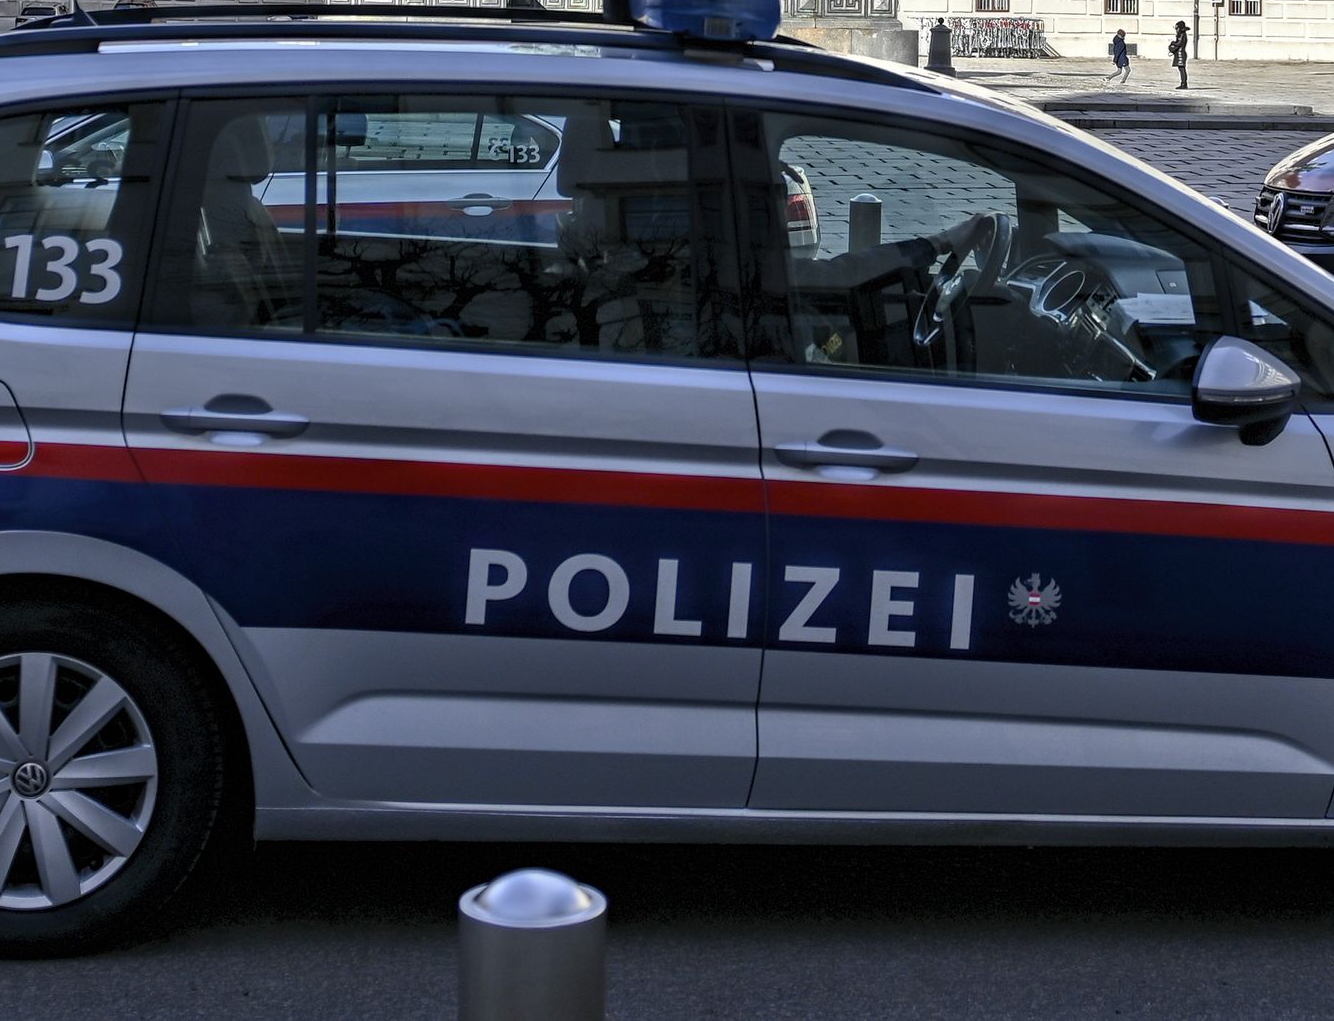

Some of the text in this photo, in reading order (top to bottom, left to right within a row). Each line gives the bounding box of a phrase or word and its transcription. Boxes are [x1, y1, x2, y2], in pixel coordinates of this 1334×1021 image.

[507, 144, 541, 163] 133
[4, 234, 123, 304] 133
[465, 547, 975, 650] POLIZEI
